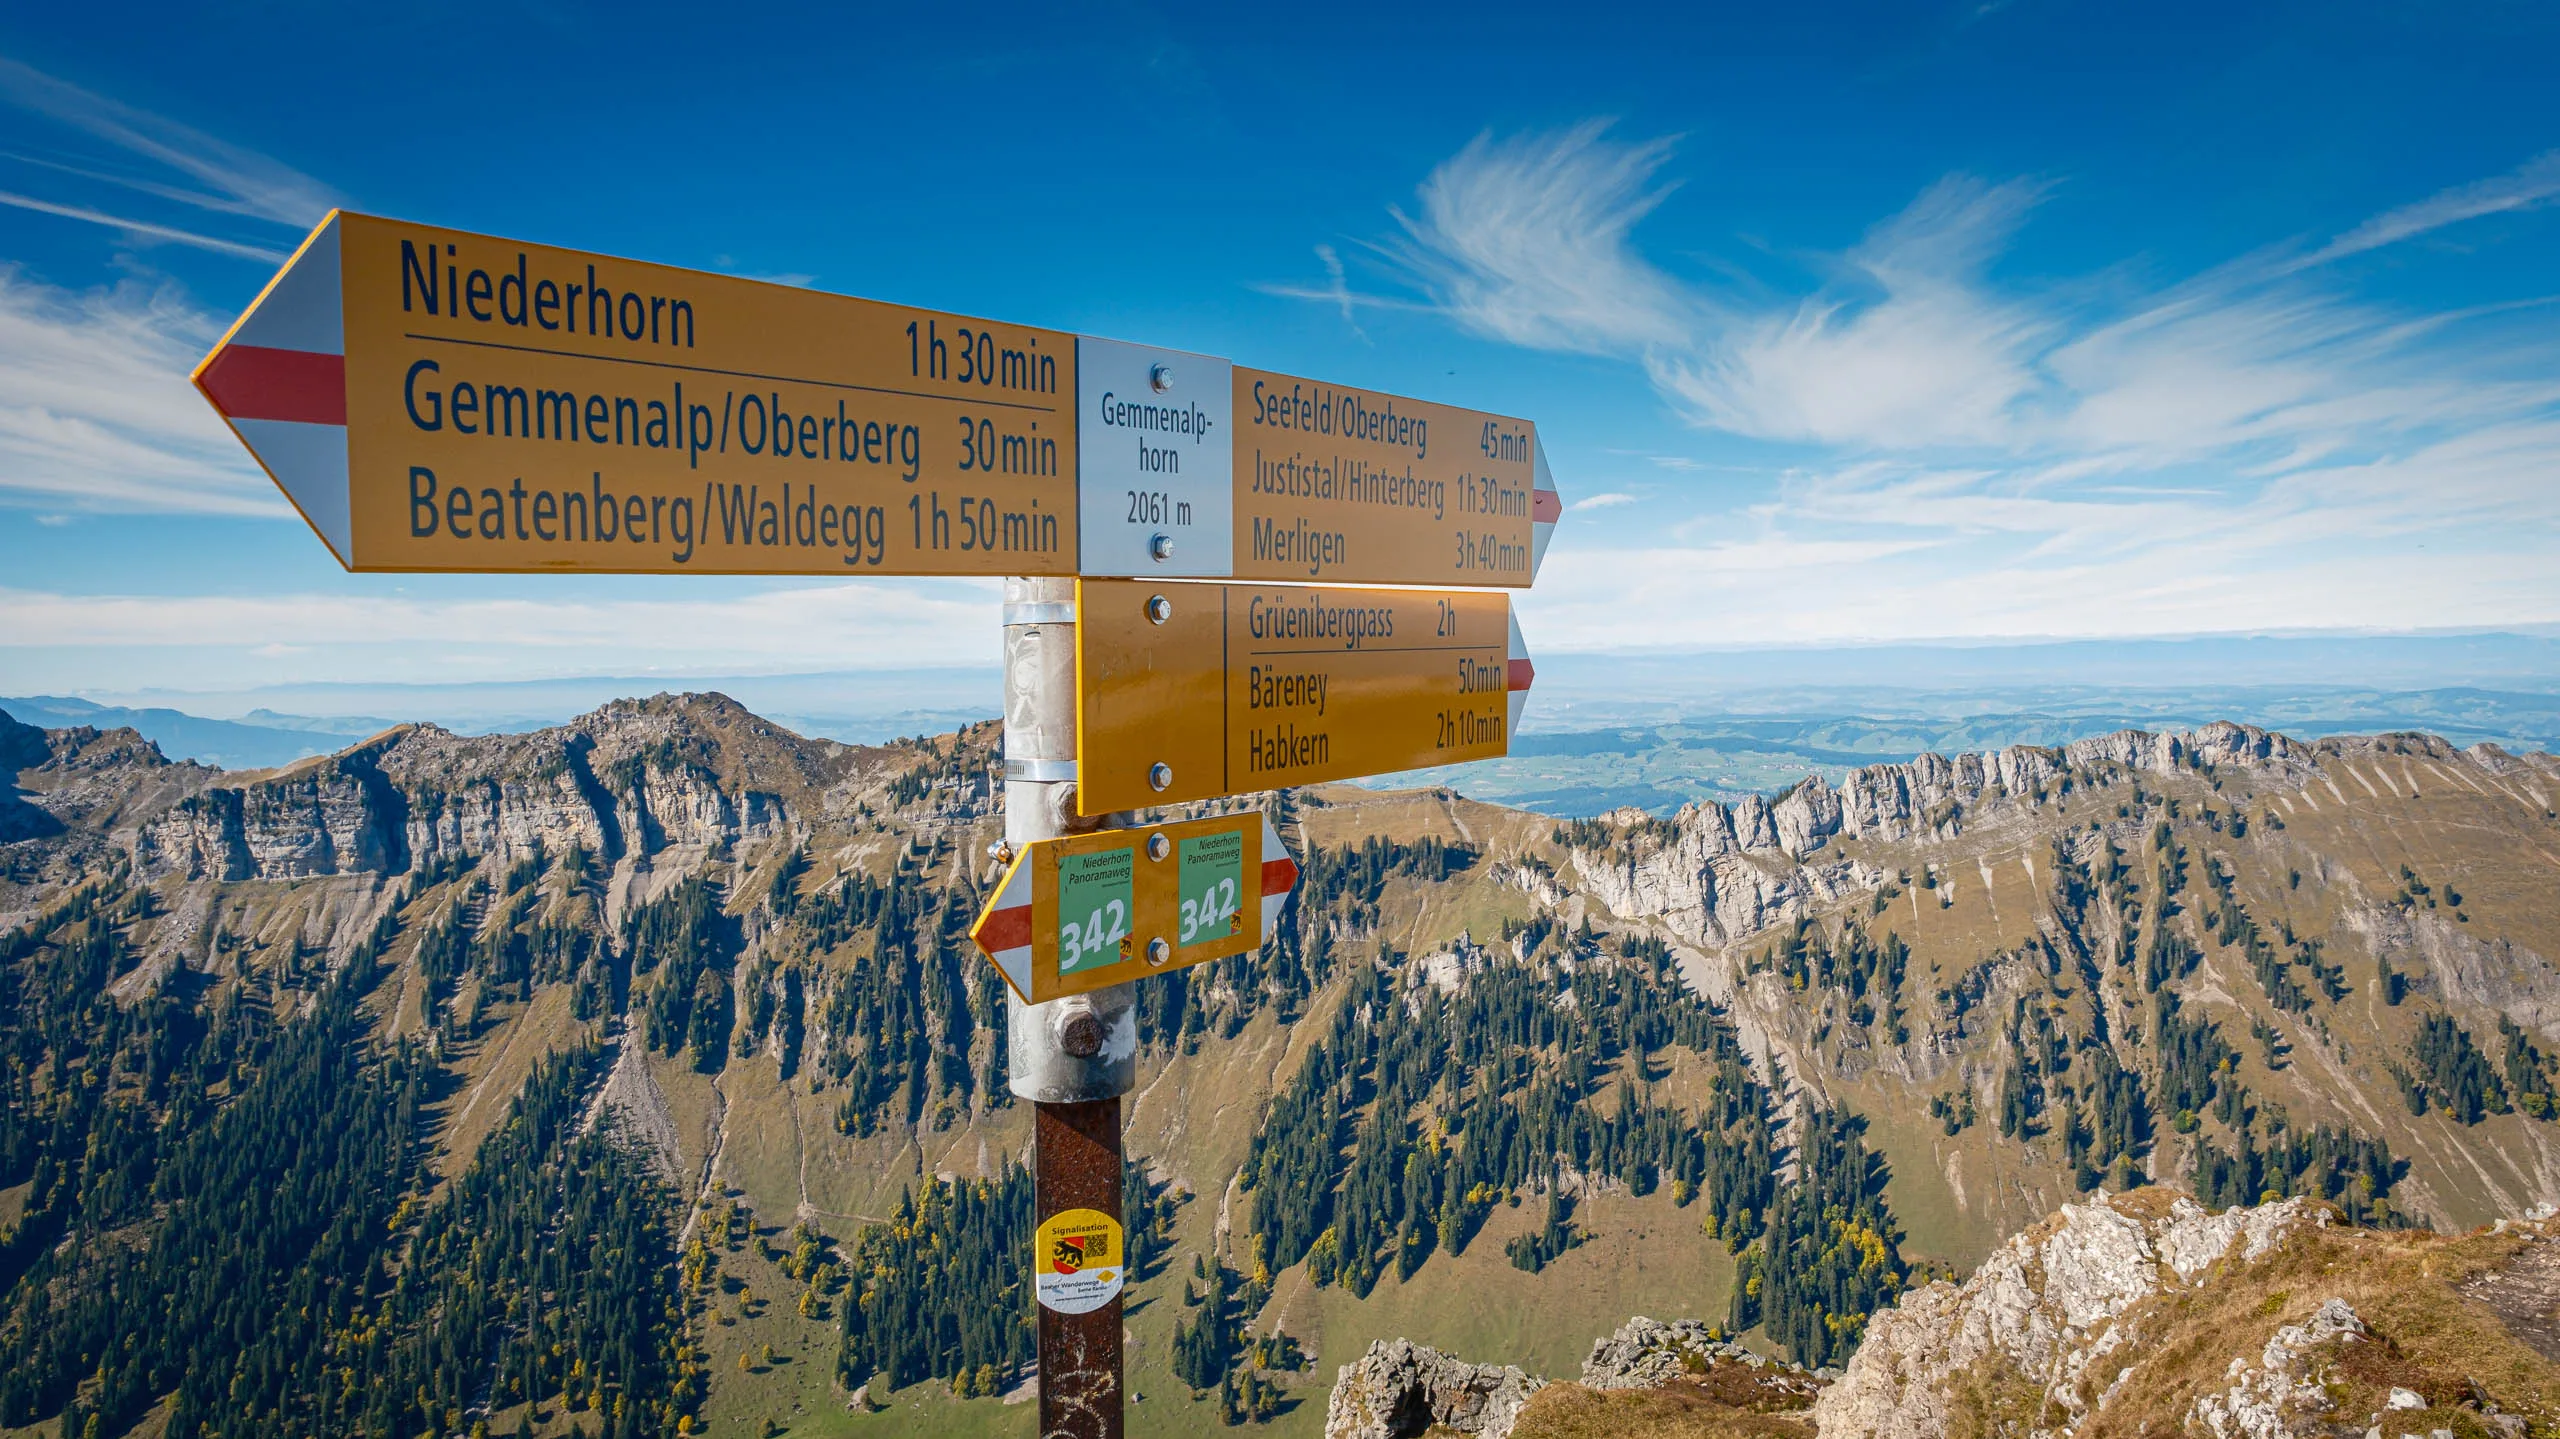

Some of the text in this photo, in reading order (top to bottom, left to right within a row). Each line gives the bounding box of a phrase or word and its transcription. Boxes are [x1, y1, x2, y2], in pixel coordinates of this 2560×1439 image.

[401, 239, 695, 348] Niederhorn
[405, 360, 920, 483] Gemmenalp/Oberberg
[1102, 392, 1212, 444] Gemmenalp-
[1253, 381, 1427, 459] Seefeld/Oberberg
[1140, 437, 1179, 474] horn
[1127, 491, 1191, 526] 2061 m
[1252, 449, 1444, 520] Justistal/Hinterberg
[409, 466, 885, 566] Beatenberg/Waldegg
[1253, 517, 1345, 575] Merligen
[1249, 595, 1456, 649] Grüenibergpass 2h
[1250, 666, 1328, 716] Bäreney
[1250, 724, 1329, 772] Habkern
[1082, 853, 1130, 870] Niederhorn
[1187, 849, 1240, 865] Panoramaweg
[1199, 836, 1240, 850] Niederhorn
[1069, 867, 1130, 885] Panoramaweg
[1061, 899, 1125, 970] 342
[1181, 878, 1235, 943] 342
[1052, 1224, 1108, 1235] Signalisation
